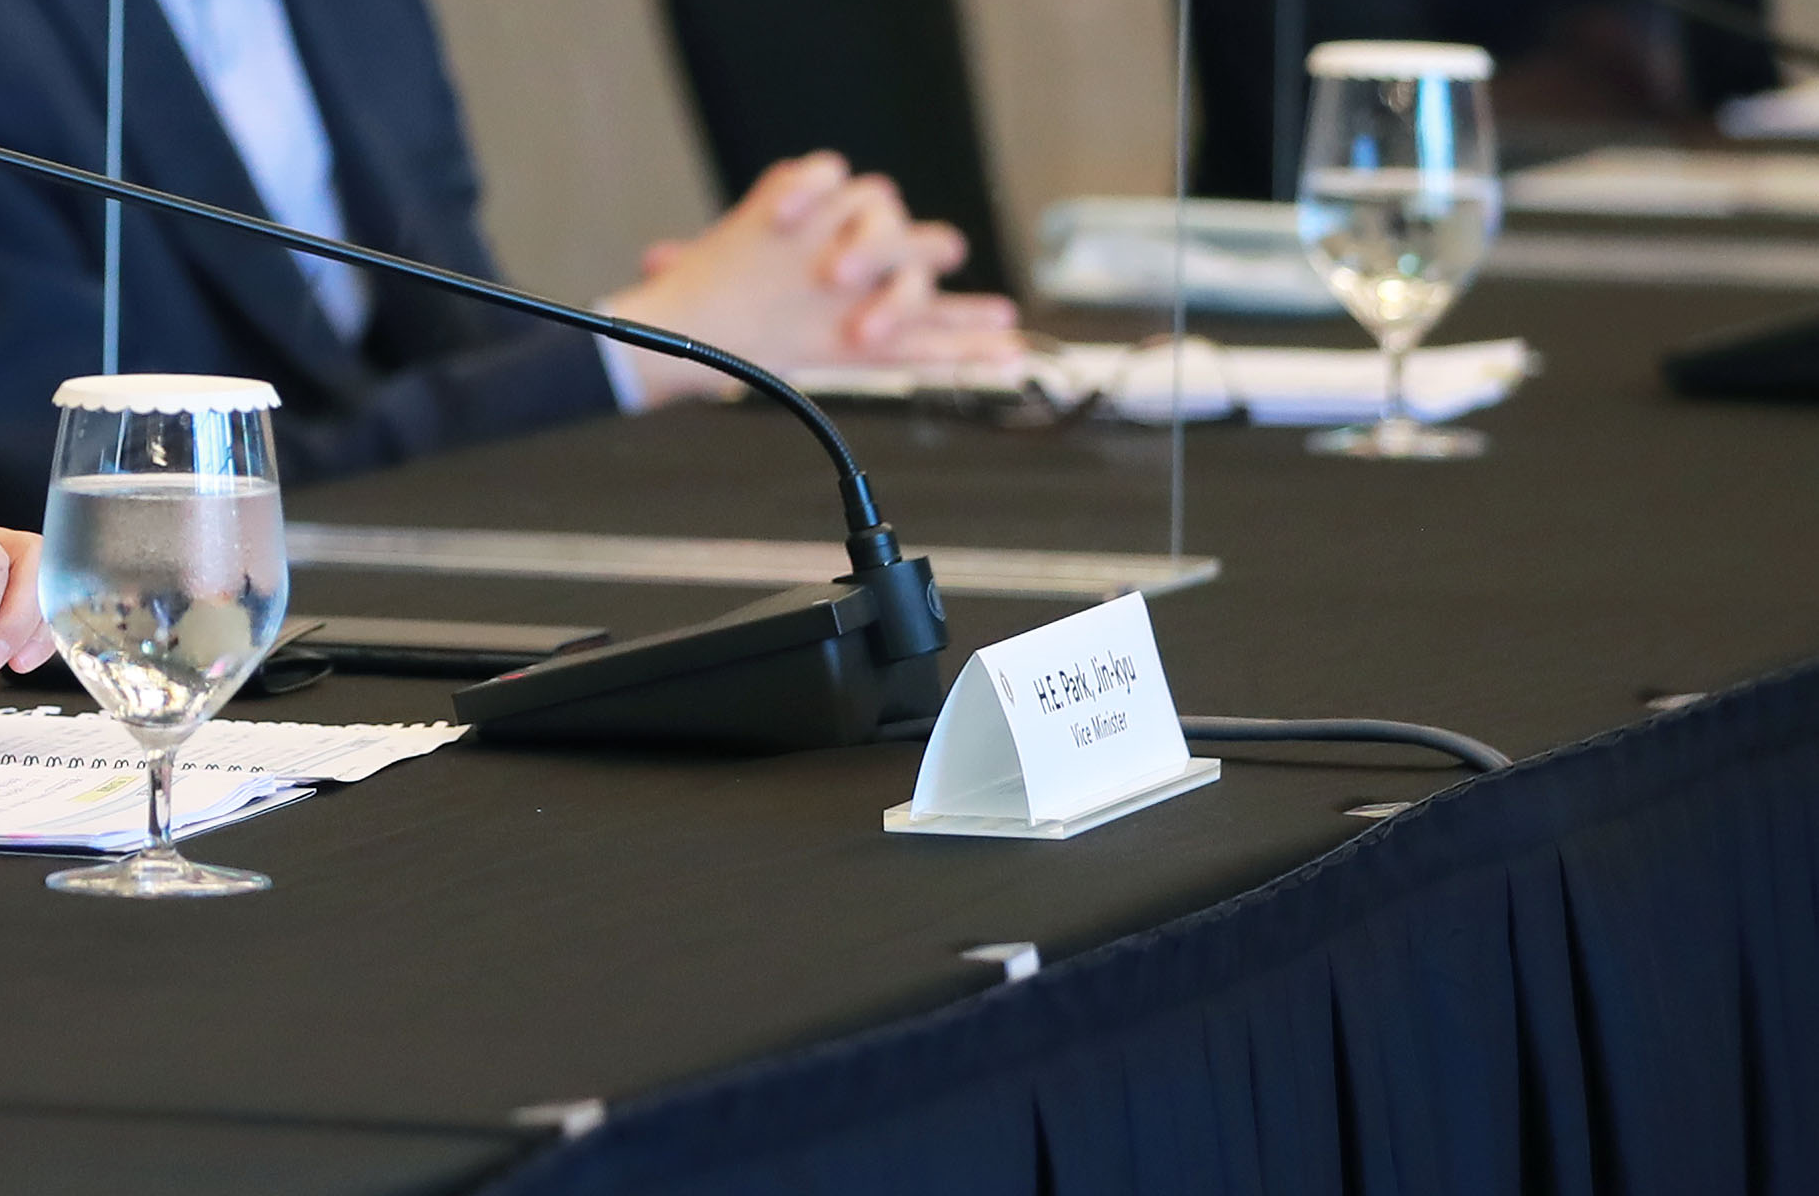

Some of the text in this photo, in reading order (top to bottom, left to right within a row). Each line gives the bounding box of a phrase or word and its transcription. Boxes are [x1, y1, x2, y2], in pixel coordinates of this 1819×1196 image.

[1033, 650, 1137, 714] H.E. Park, Jin-kyu
[1070, 711, 1128, 748] Vice Minister
